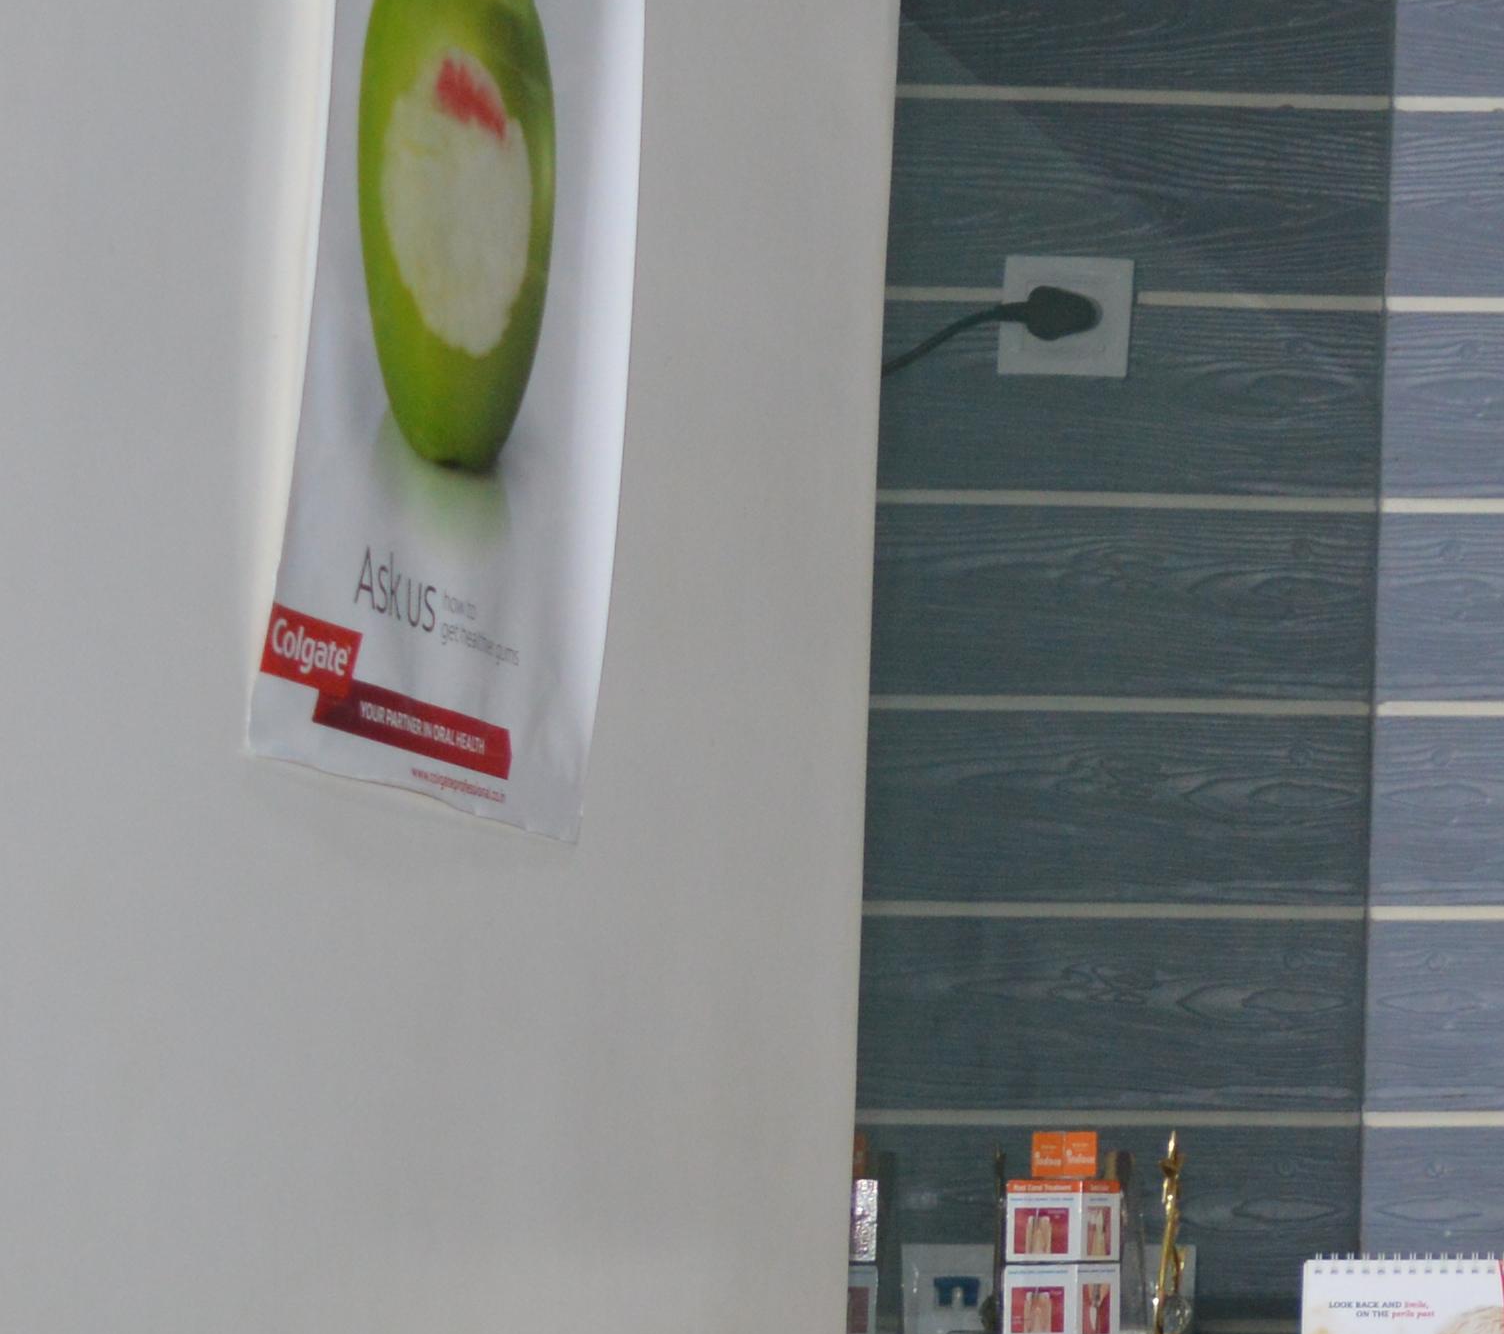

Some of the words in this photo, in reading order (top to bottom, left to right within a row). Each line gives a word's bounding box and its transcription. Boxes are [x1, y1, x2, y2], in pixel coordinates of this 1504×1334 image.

[354, 545, 401, 620] Ask
[407, 578, 436, 632] us
[272, 619, 347, 676] Colgate
[360, 701, 385, 724] YOUR
[386, 707, 422, 734] PARTNER
[434, 721, 454, 747] ORAL
[456, 730, 485, 755] HEALTH
